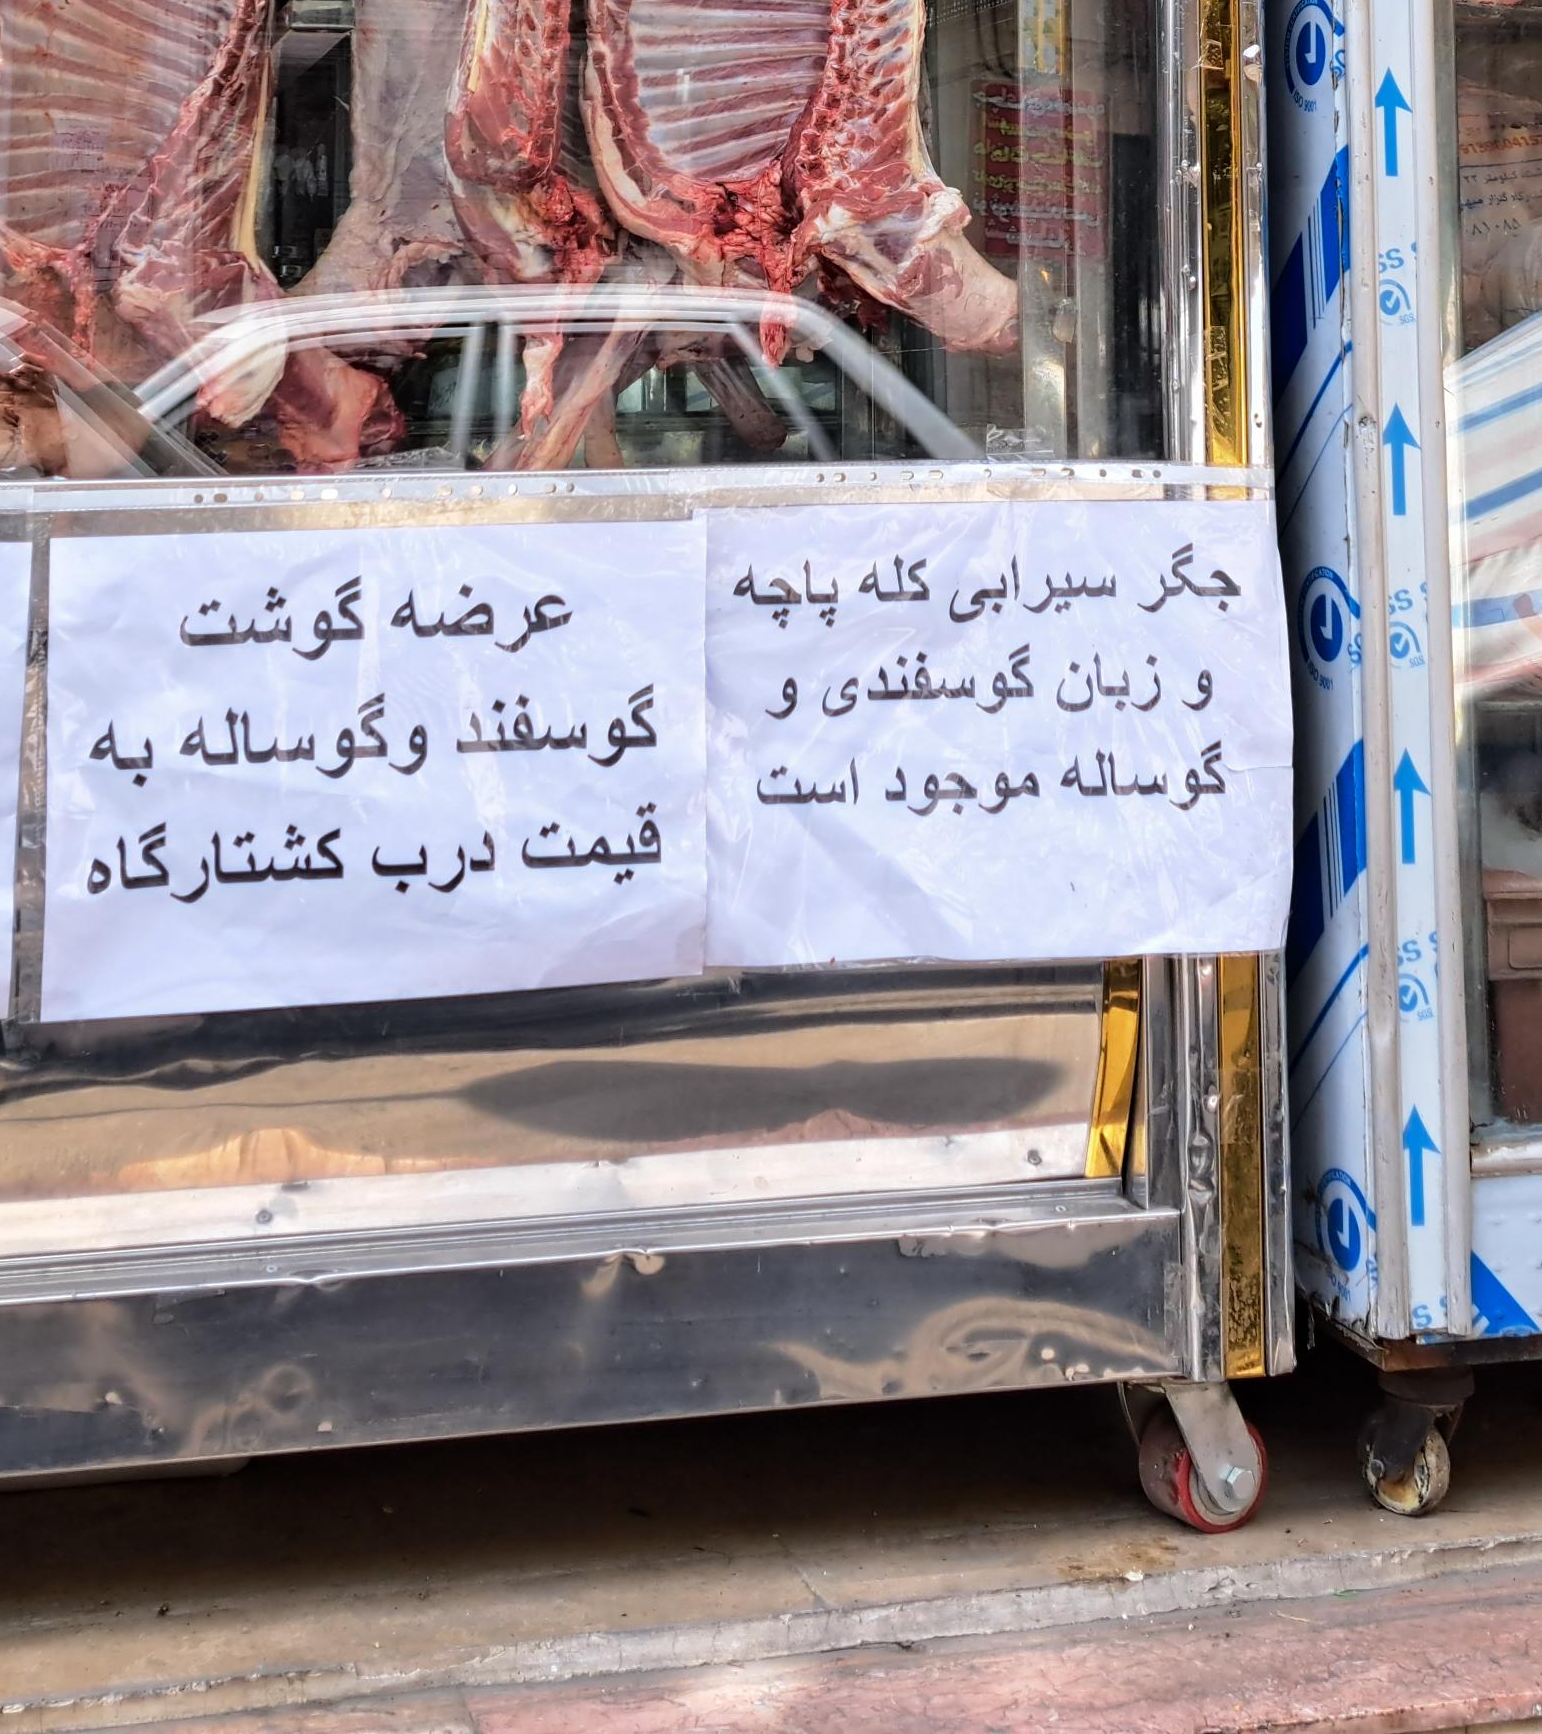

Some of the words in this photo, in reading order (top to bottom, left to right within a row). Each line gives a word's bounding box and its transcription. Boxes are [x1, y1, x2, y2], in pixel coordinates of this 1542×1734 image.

[732, 559, 839, 629] پاچه
[859, 555, 930, 603] کله
[949, 555, 1117, 623] سیرابی
[1138, 542, 1242, 613] جگر
[179, 574, 364, 661] گوشت
[391, 581, 574, 654] عرضه
[765, 675, 798, 719] و
[822, 643, 1035, 717] گوسفندی
[1056, 651, 1161, 712] زبان
[1181, 666, 1214, 711] و
[89, 719, 154, 788] به
[456, 682, 658, 768] گوسفند
[757, 757, 859, 805] است
[885, 765, 1040, 816] موجود
[1059, 739, 1227, 811] گوساله
[86, 821, 344, 904] کشتارگاه
[370, 830, 496, 894] درب
[520, 800, 662, 886] قیمت
